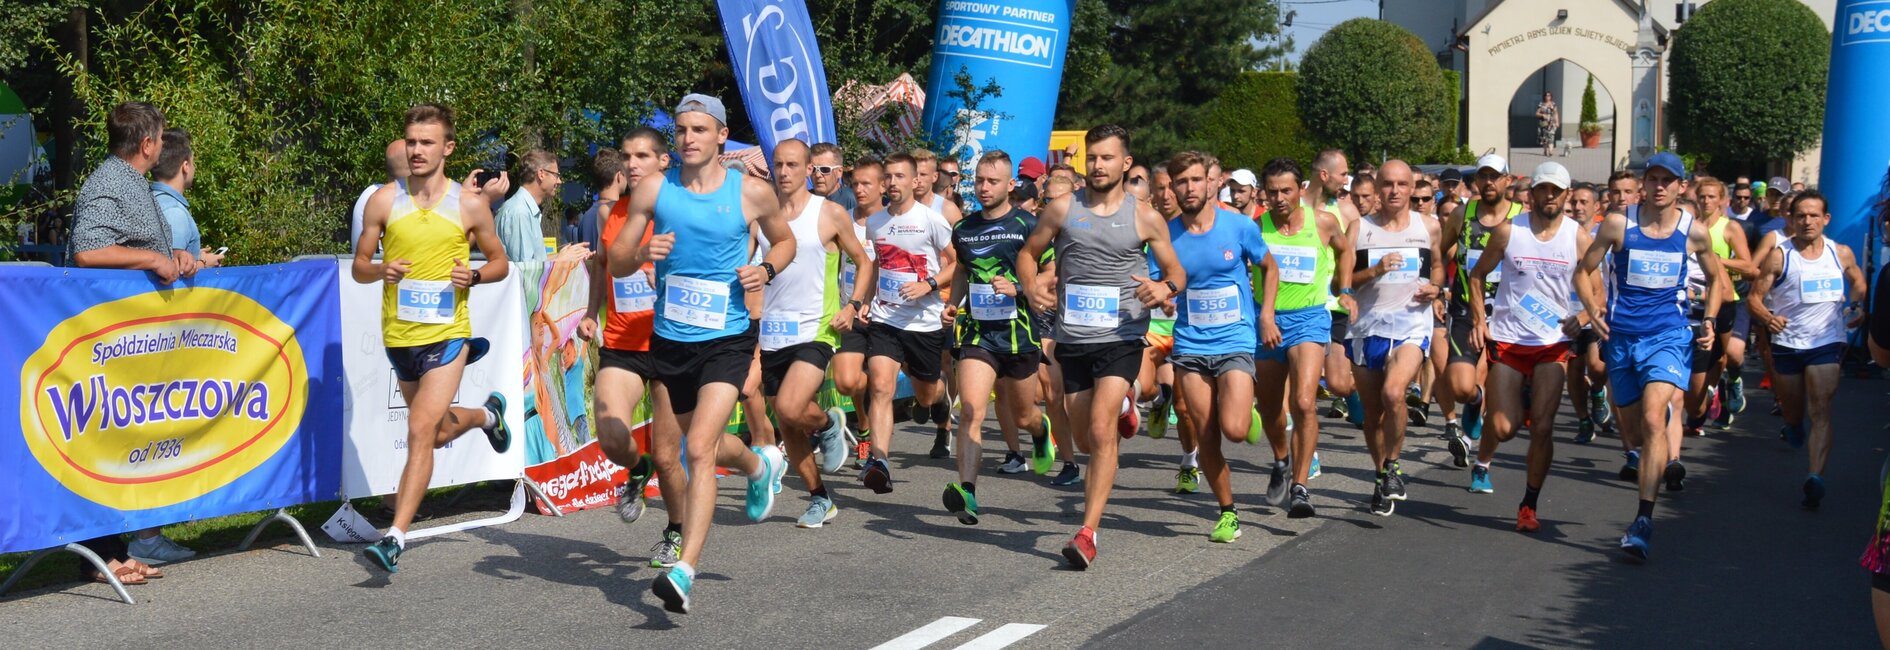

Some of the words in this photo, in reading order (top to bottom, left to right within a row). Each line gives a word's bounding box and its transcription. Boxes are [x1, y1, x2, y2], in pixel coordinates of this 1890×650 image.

[945, 0, 1000, 15] SPORTOWY
[1002, 6, 1055, 24] PARTNER
[939, 24, 1051, 59] DECATHLON
[991, 233, 1025, 241] BIEGANIA
[1281, 255, 1301, 267] 44
[1641, 260, 1669, 274] 346
[623, 282, 652, 295] 505
[886, 279, 905, 290] 42
[1816, 279, 1831, 289] 16
[410, 291, 441, 305] 506
[679, 289, 712, 308] 202
[1077, 296, 1106, 310] 500
[1199, 298, 1228, 311] 356
[1530, 301, 1556, 321] 477
[766, 321, 788, 333] 331
[92, 333, 177, 365] Spółdzielnia
[179, 330, 237, 353] Mleczarska
[46, 373, 269, 442] Włoszczowa
[128, 442, 153, 464] od
[152, 438, 184, 461] 1936
